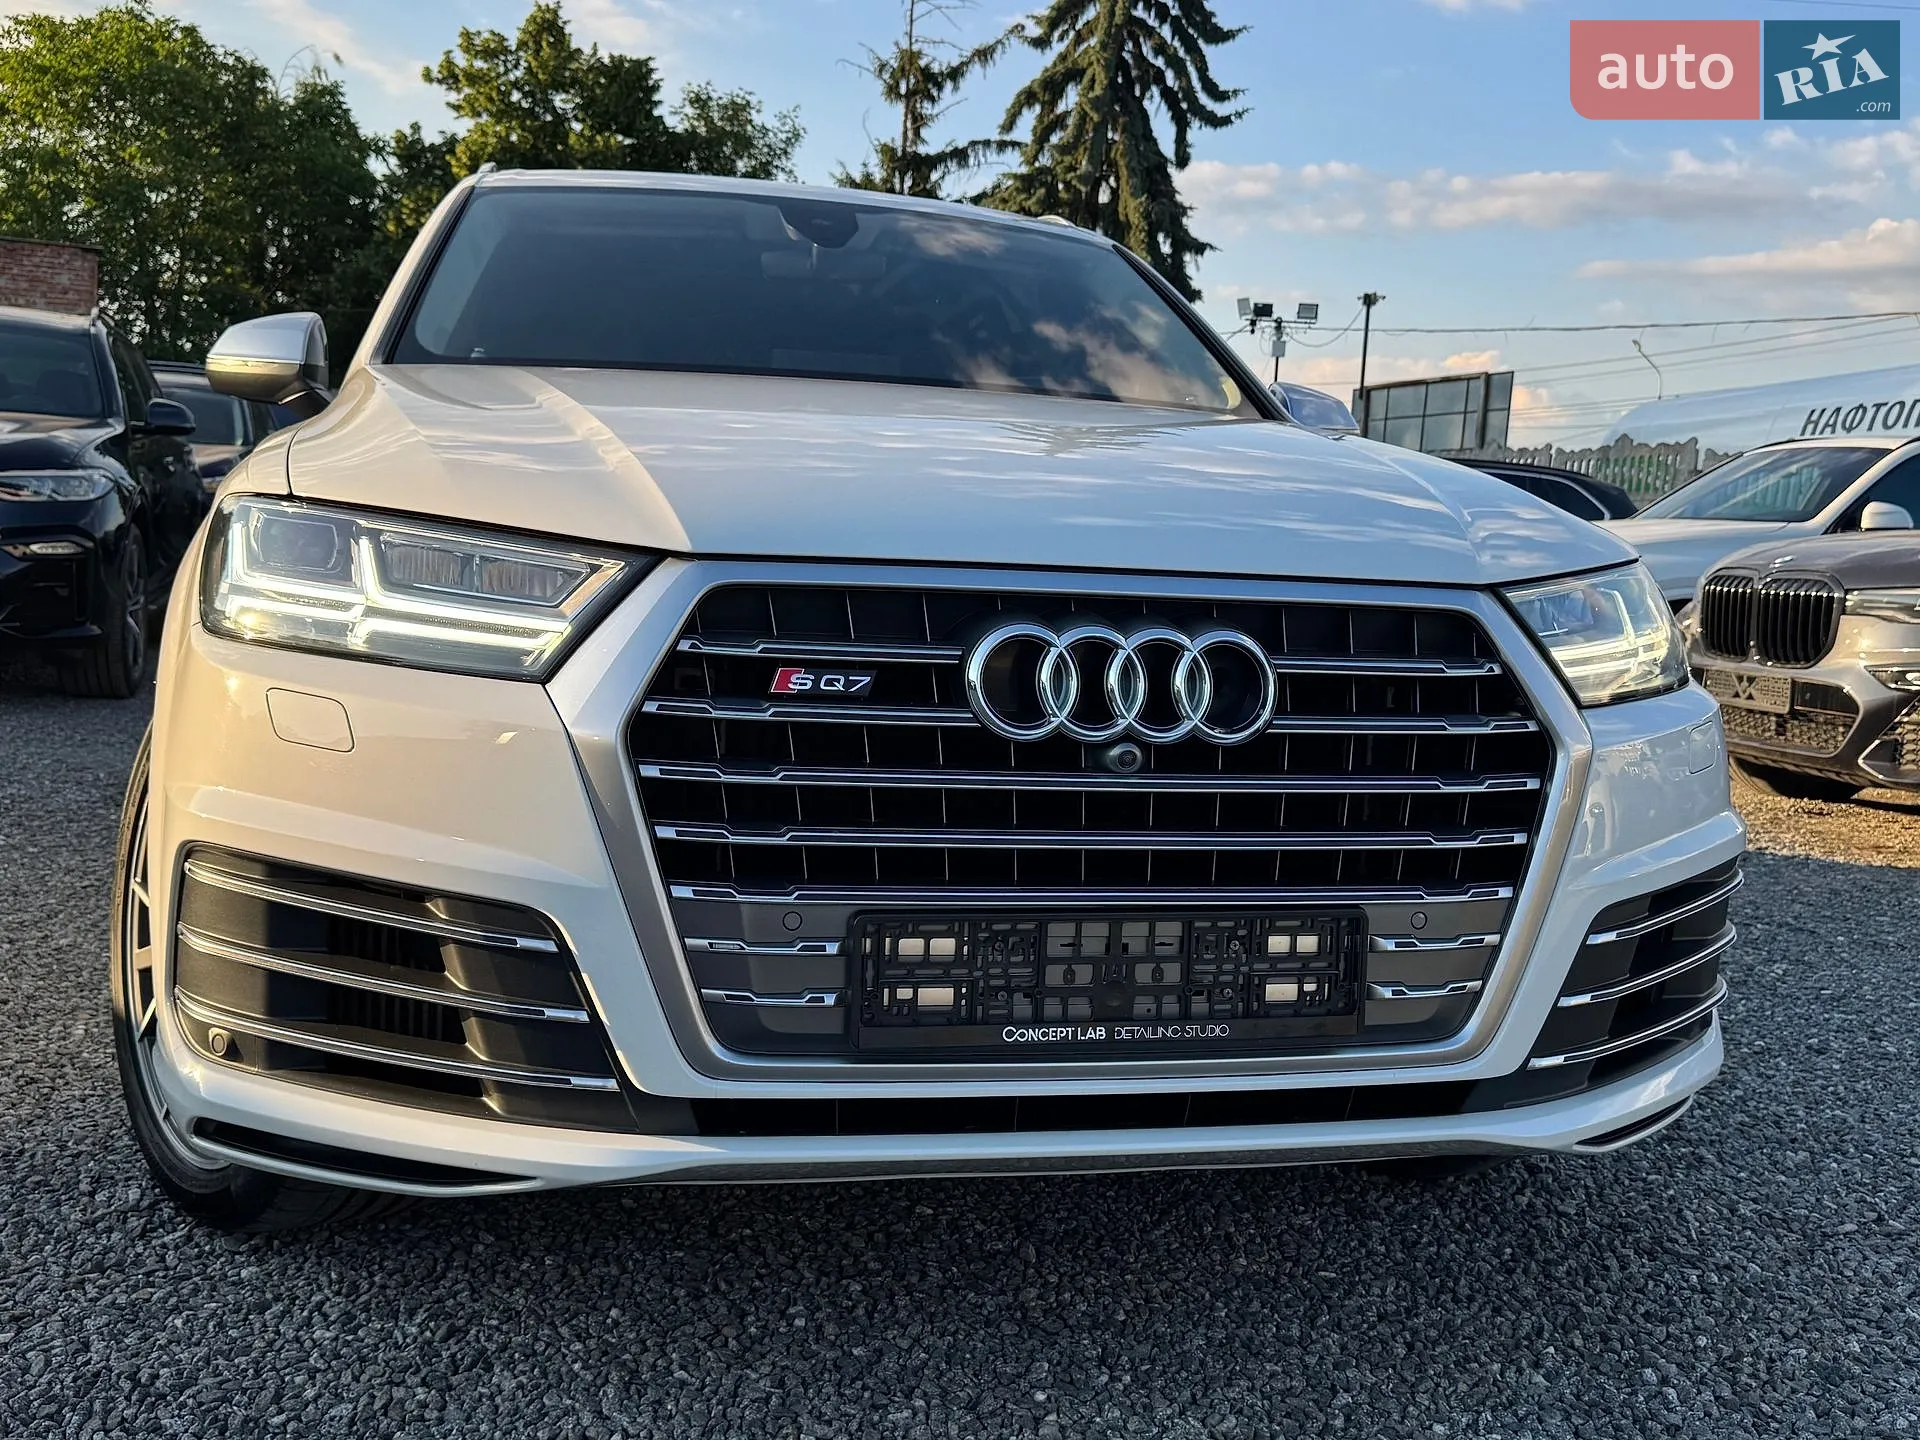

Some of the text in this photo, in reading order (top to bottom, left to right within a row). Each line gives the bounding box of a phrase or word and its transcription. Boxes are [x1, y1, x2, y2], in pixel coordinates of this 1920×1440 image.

[786, 672, 872, 692] SQ7
[1002, 1025, 1075, 1042] CONCEPT
[1077, 1026, 1106, 1041] LAB
[1183, 1024, 1230, 1038] STUDIO
